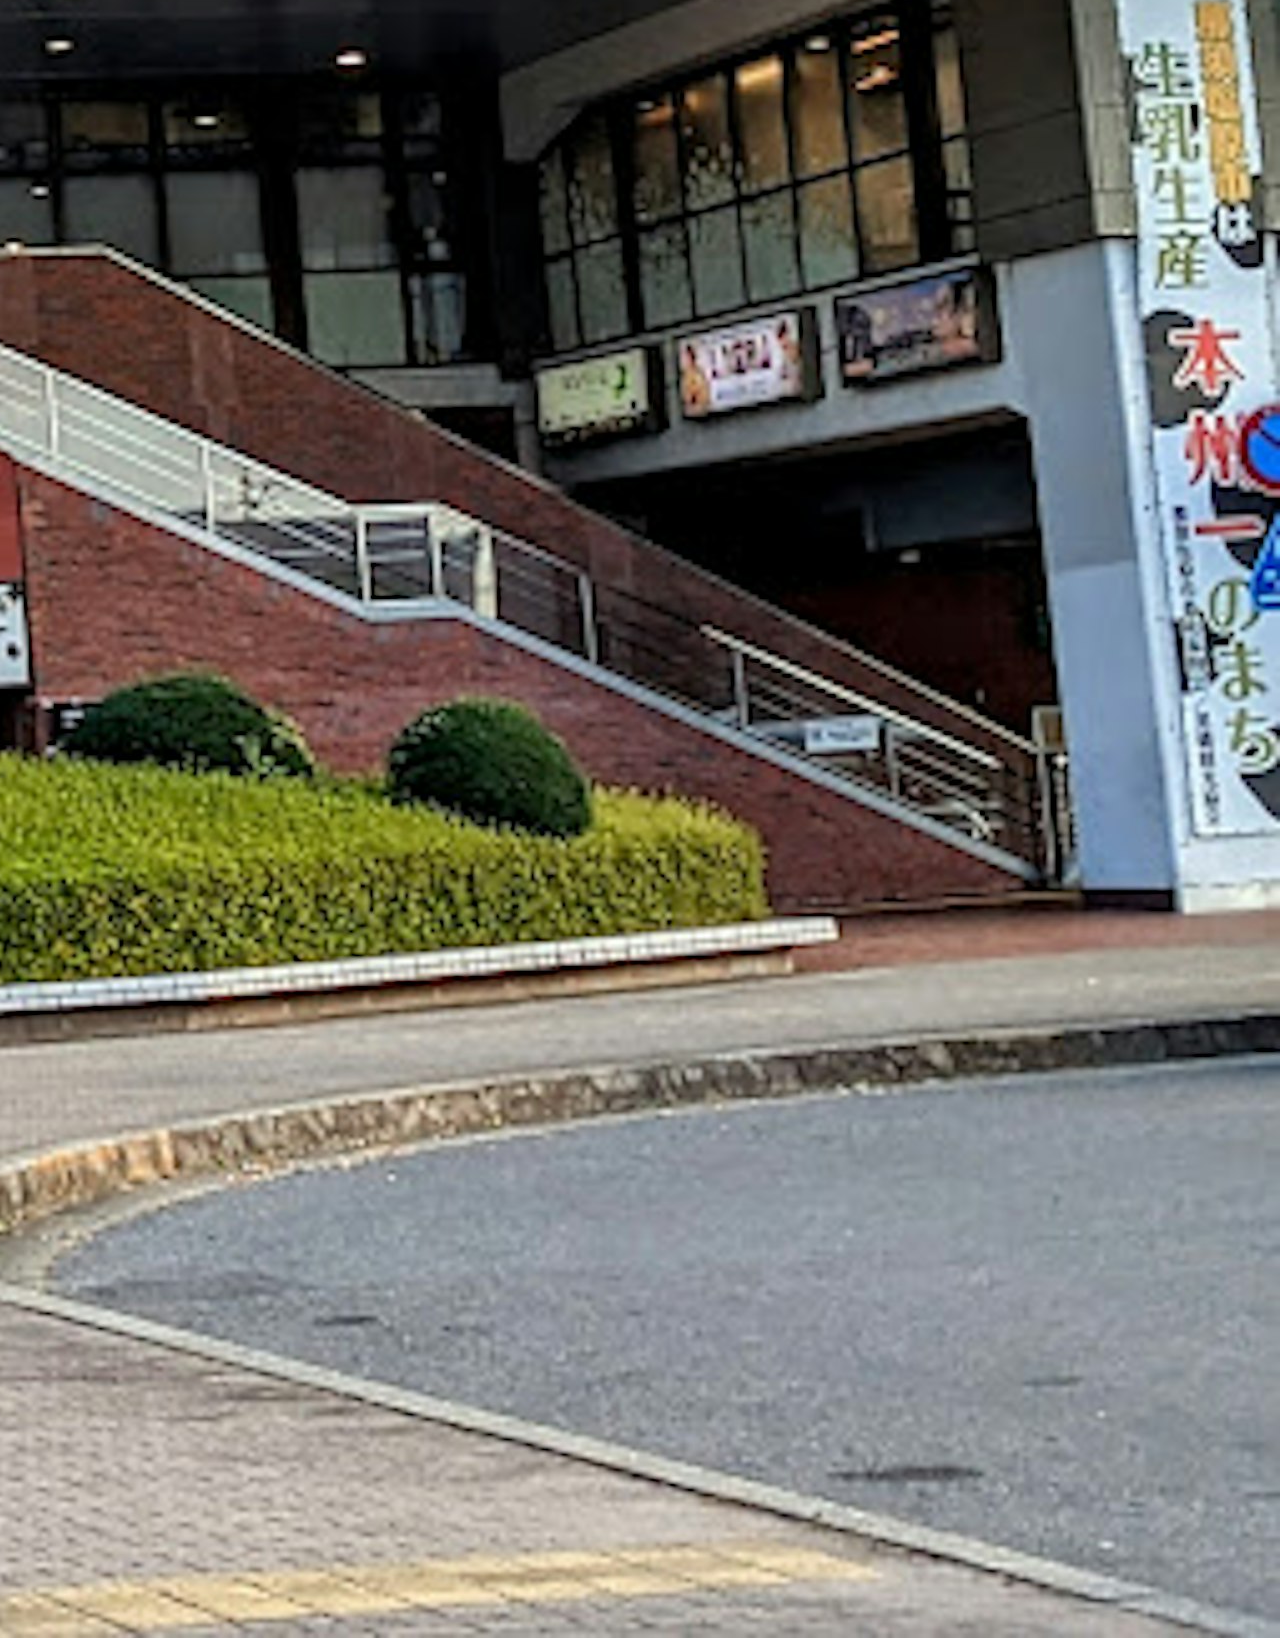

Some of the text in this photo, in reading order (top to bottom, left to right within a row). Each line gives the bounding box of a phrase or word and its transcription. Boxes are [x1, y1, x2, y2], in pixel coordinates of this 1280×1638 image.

[1169, 318, 1277, 768] 本州一のまち
